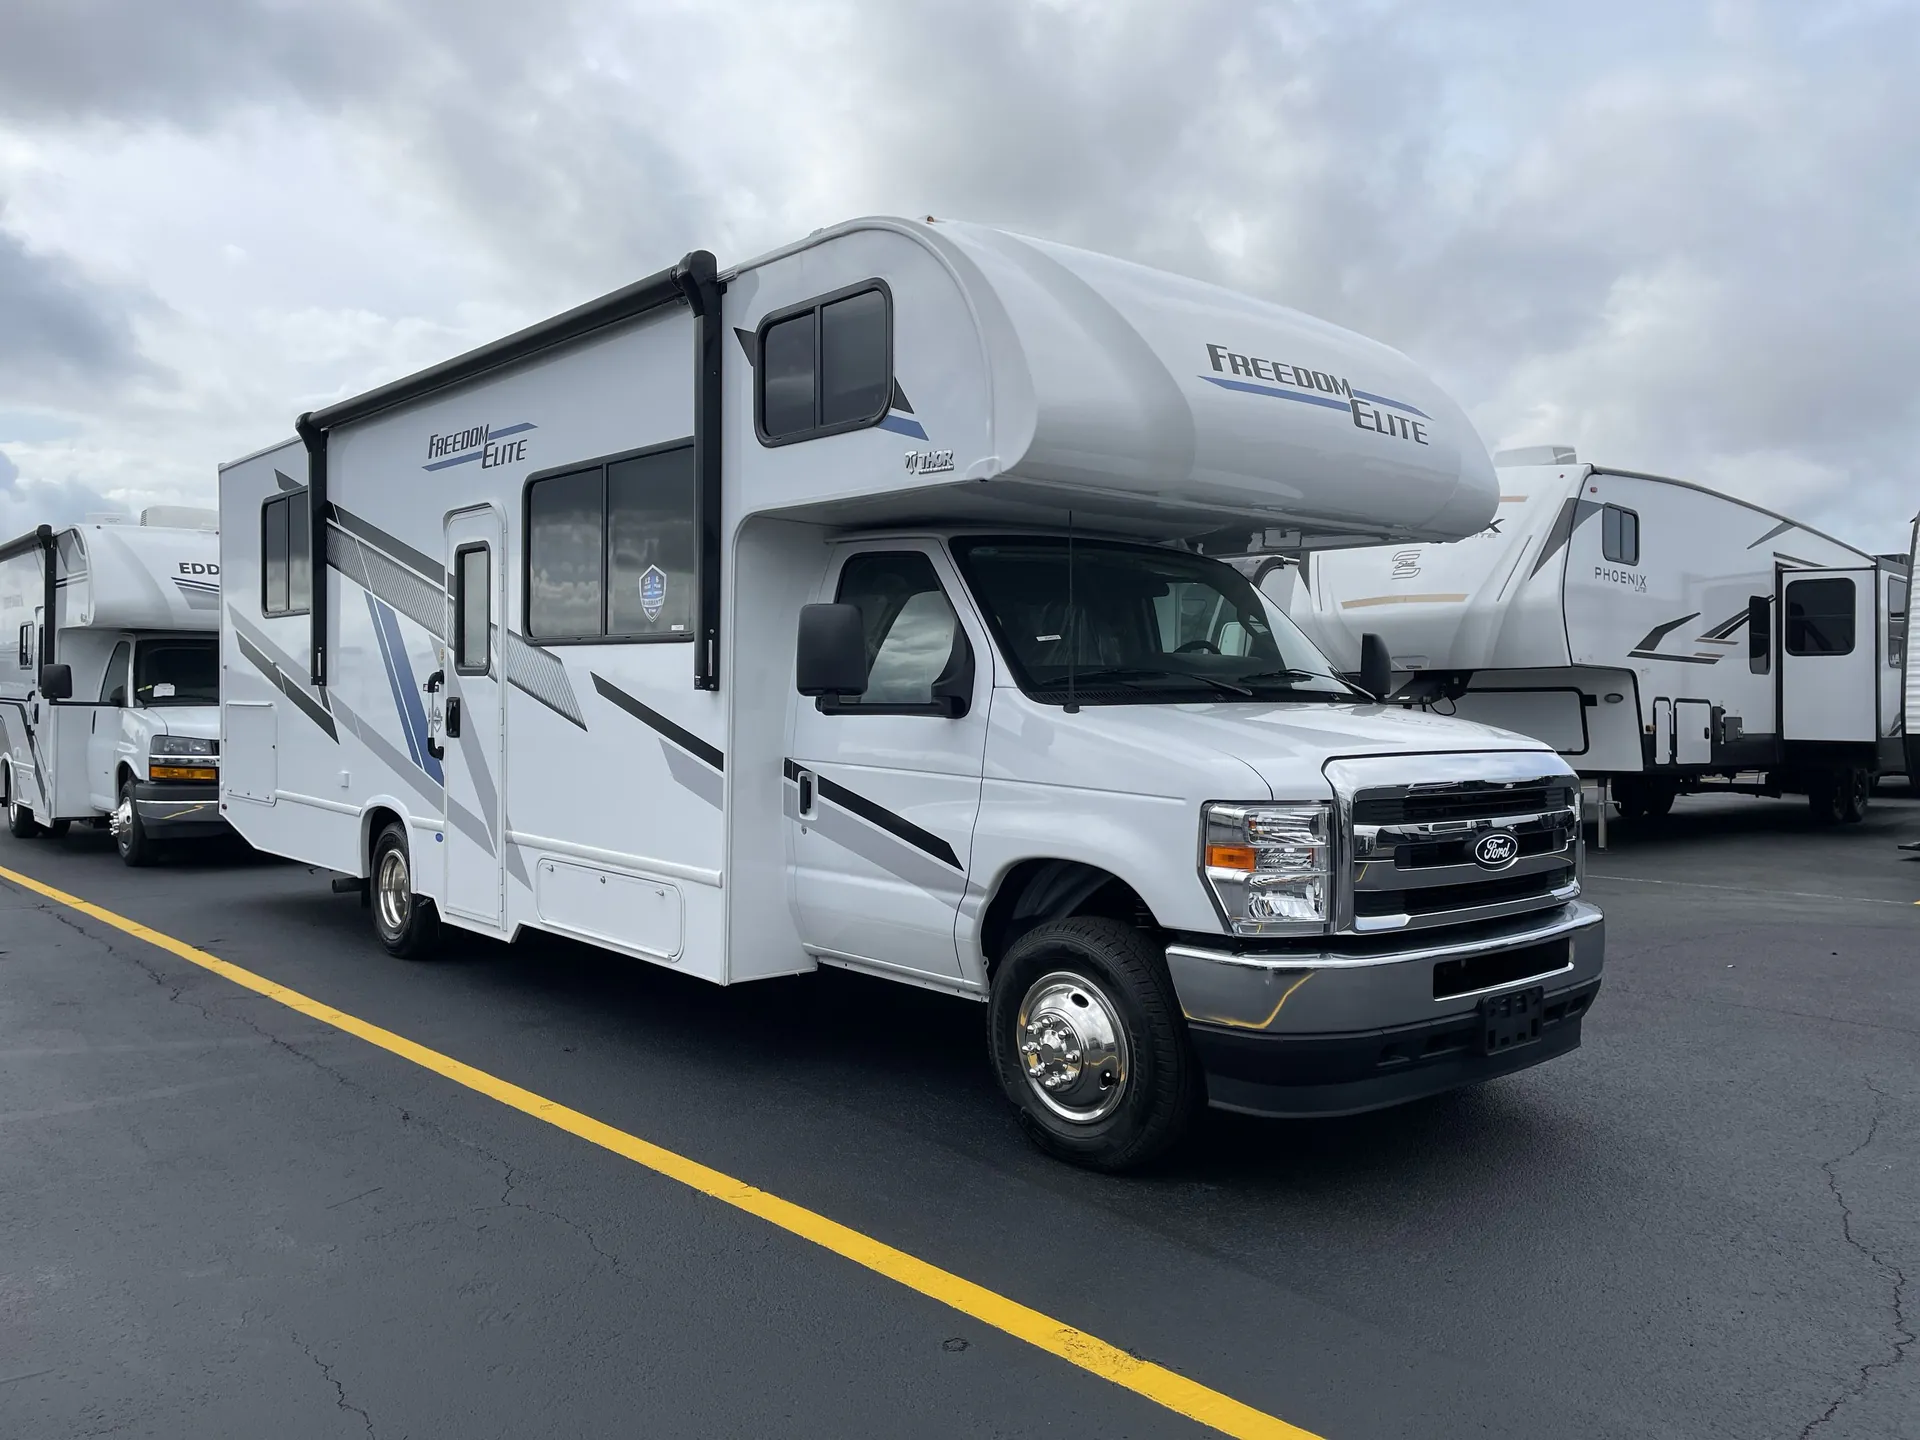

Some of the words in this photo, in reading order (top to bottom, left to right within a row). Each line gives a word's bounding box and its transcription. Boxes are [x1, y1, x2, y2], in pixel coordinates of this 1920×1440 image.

[1206, 343, 1353, 399] FREEDOM
[1350, 399, 1429, 446] ELITE
[428, 424, 490, 460] FREEDOM
[481, 439, 528, 469] ELITE
[1594, 566, 1647, 588] PHOENIX
[1483, 838, 1511, 860] Ford
